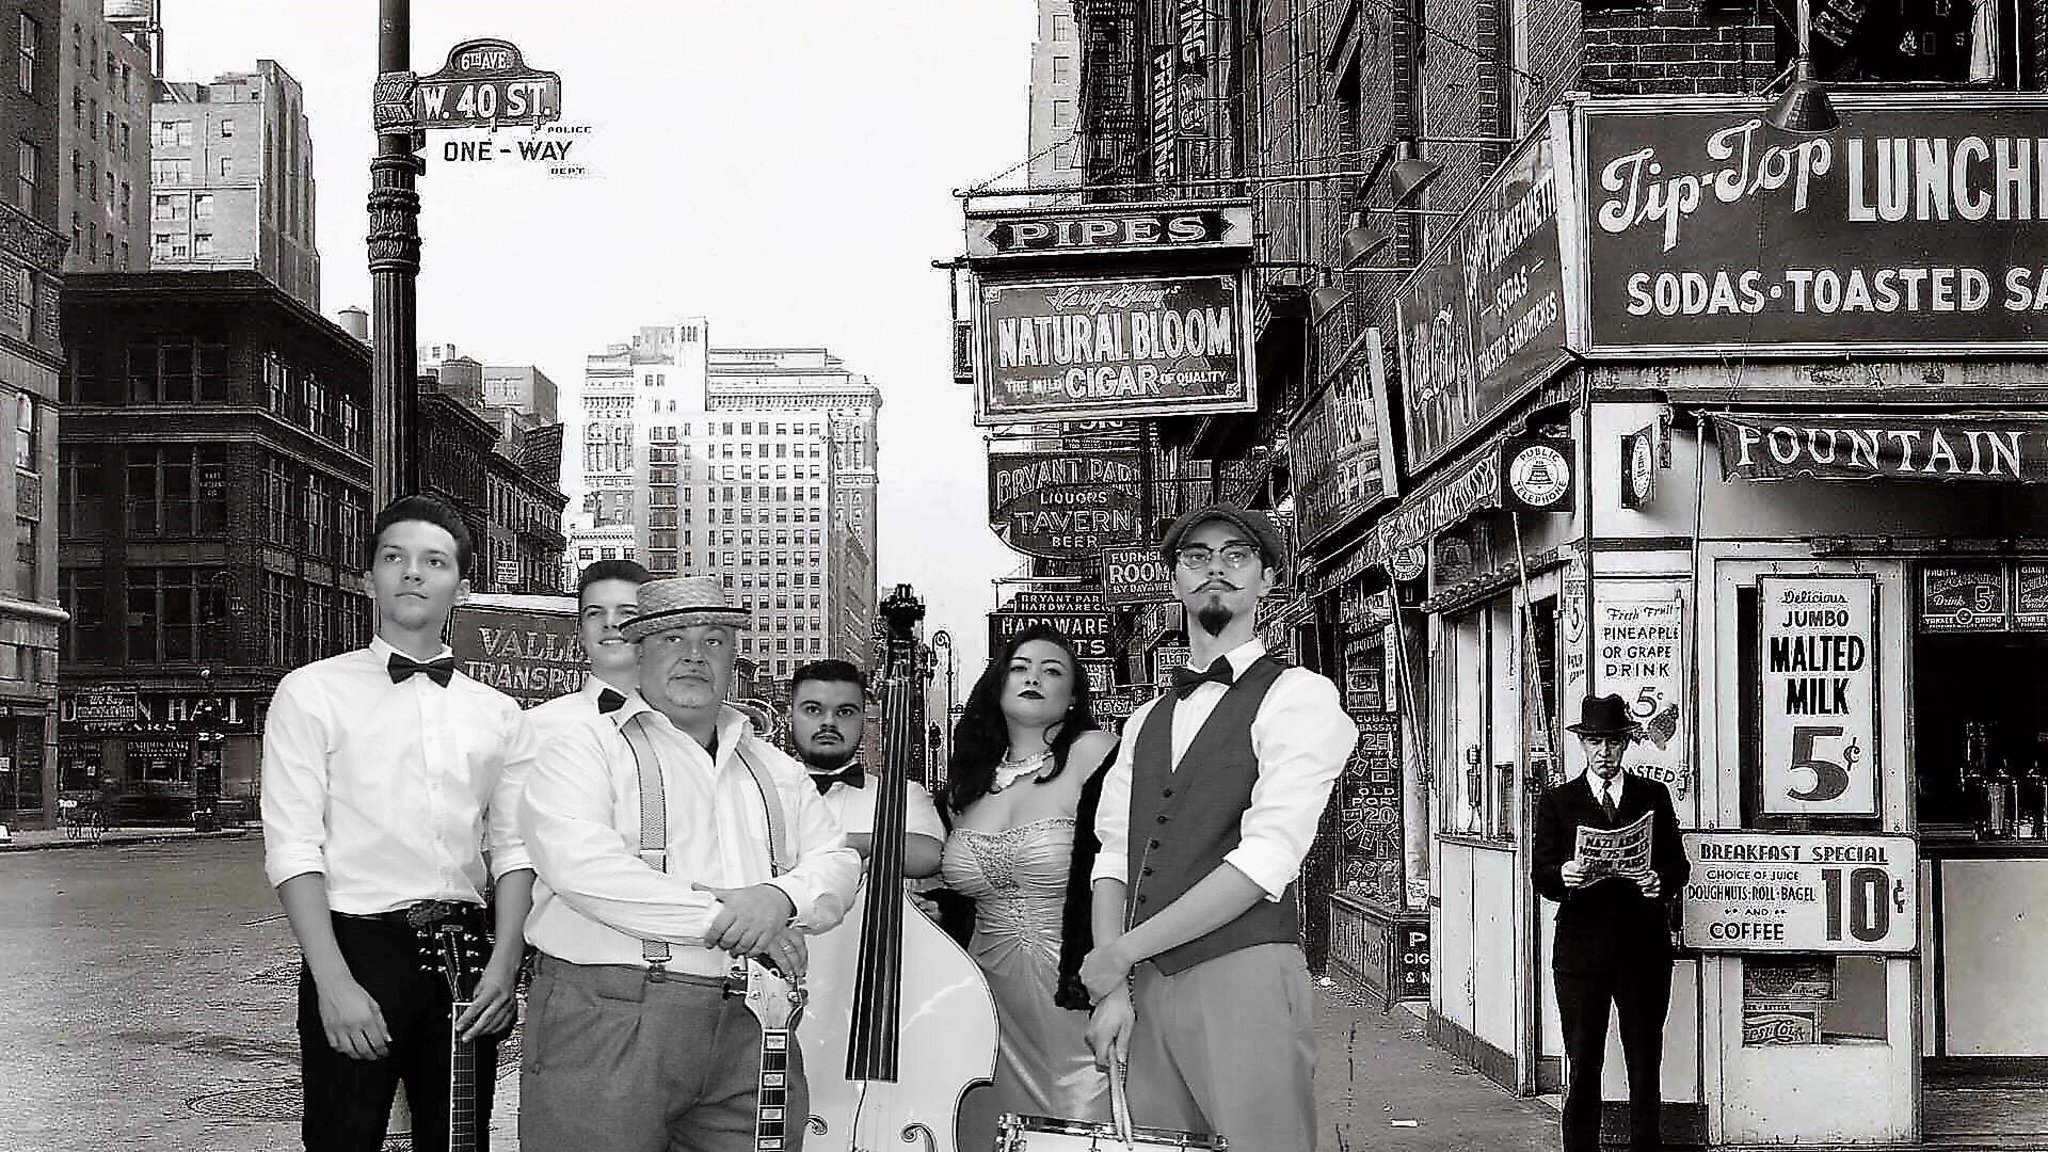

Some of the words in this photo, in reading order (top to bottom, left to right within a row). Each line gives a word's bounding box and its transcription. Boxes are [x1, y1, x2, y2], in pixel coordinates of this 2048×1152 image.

[420, 85, 450, 120] W.
[456, 84, 498, 119] 40
[506, 82, 551, 117] ST.
[1598, 119, 1832, 253] Tip-Top
[1011, 216, 1206, 250] PIPES
[1627, 269, 1767, 316] SODAS
[1785, 267, 1992, 314] TOASTED
[999, 311, 1129, 368] NATURAL
[1130, 306, 1233, 360] BLOOM
[1065, 364, 1160, 399] CIGAR
[1519, 446, 1562, 463] PUBLIC
[1736, 424, 2032, 479] FOUNTAIN
[997, 458, 1083, 507] BRYANT
[1040, 491, 1108, 505] LIQUORS
[1513, 479, 1567, 505] TELEPHONE
[1013, 509, 1132, 535] TAVERN
[1052, 535, 1099, 549] BEER
[1021, 594, 1071, 603] BRYANT
[1781, 590, 1848, 604] Delicious
[1021, 603, 1091, 612] HARDWARE
[1606, 607, 1640, 621] Fresh
[1782, 610, 1849, 628] JUMBO
[1603, 626, 1679, 640] PINEAPPLE
[1603, 645, 1621, 659] OR
[1627, 645, 1672, 659] GRAPE
[1769, 635, 1865, 672] MALTED
[1605, 663, 1670, 677] DRINK
[1786, 678, 1850, 715] MILK
[1358, 787, 1395, 796] OLD
[1700, 843, 1801, 861] BREAKFAST
[1812, 845, 1889, 862] SPECIAL
[1706, 869, 1751, 880] CHOICE
[1753, 870, 1768, 880] OF
[1770, 870, 1800, 881] JUICE
[1744, 908, 1769, 916] AND
[1709, 922, 1784, 941] COFFEE
